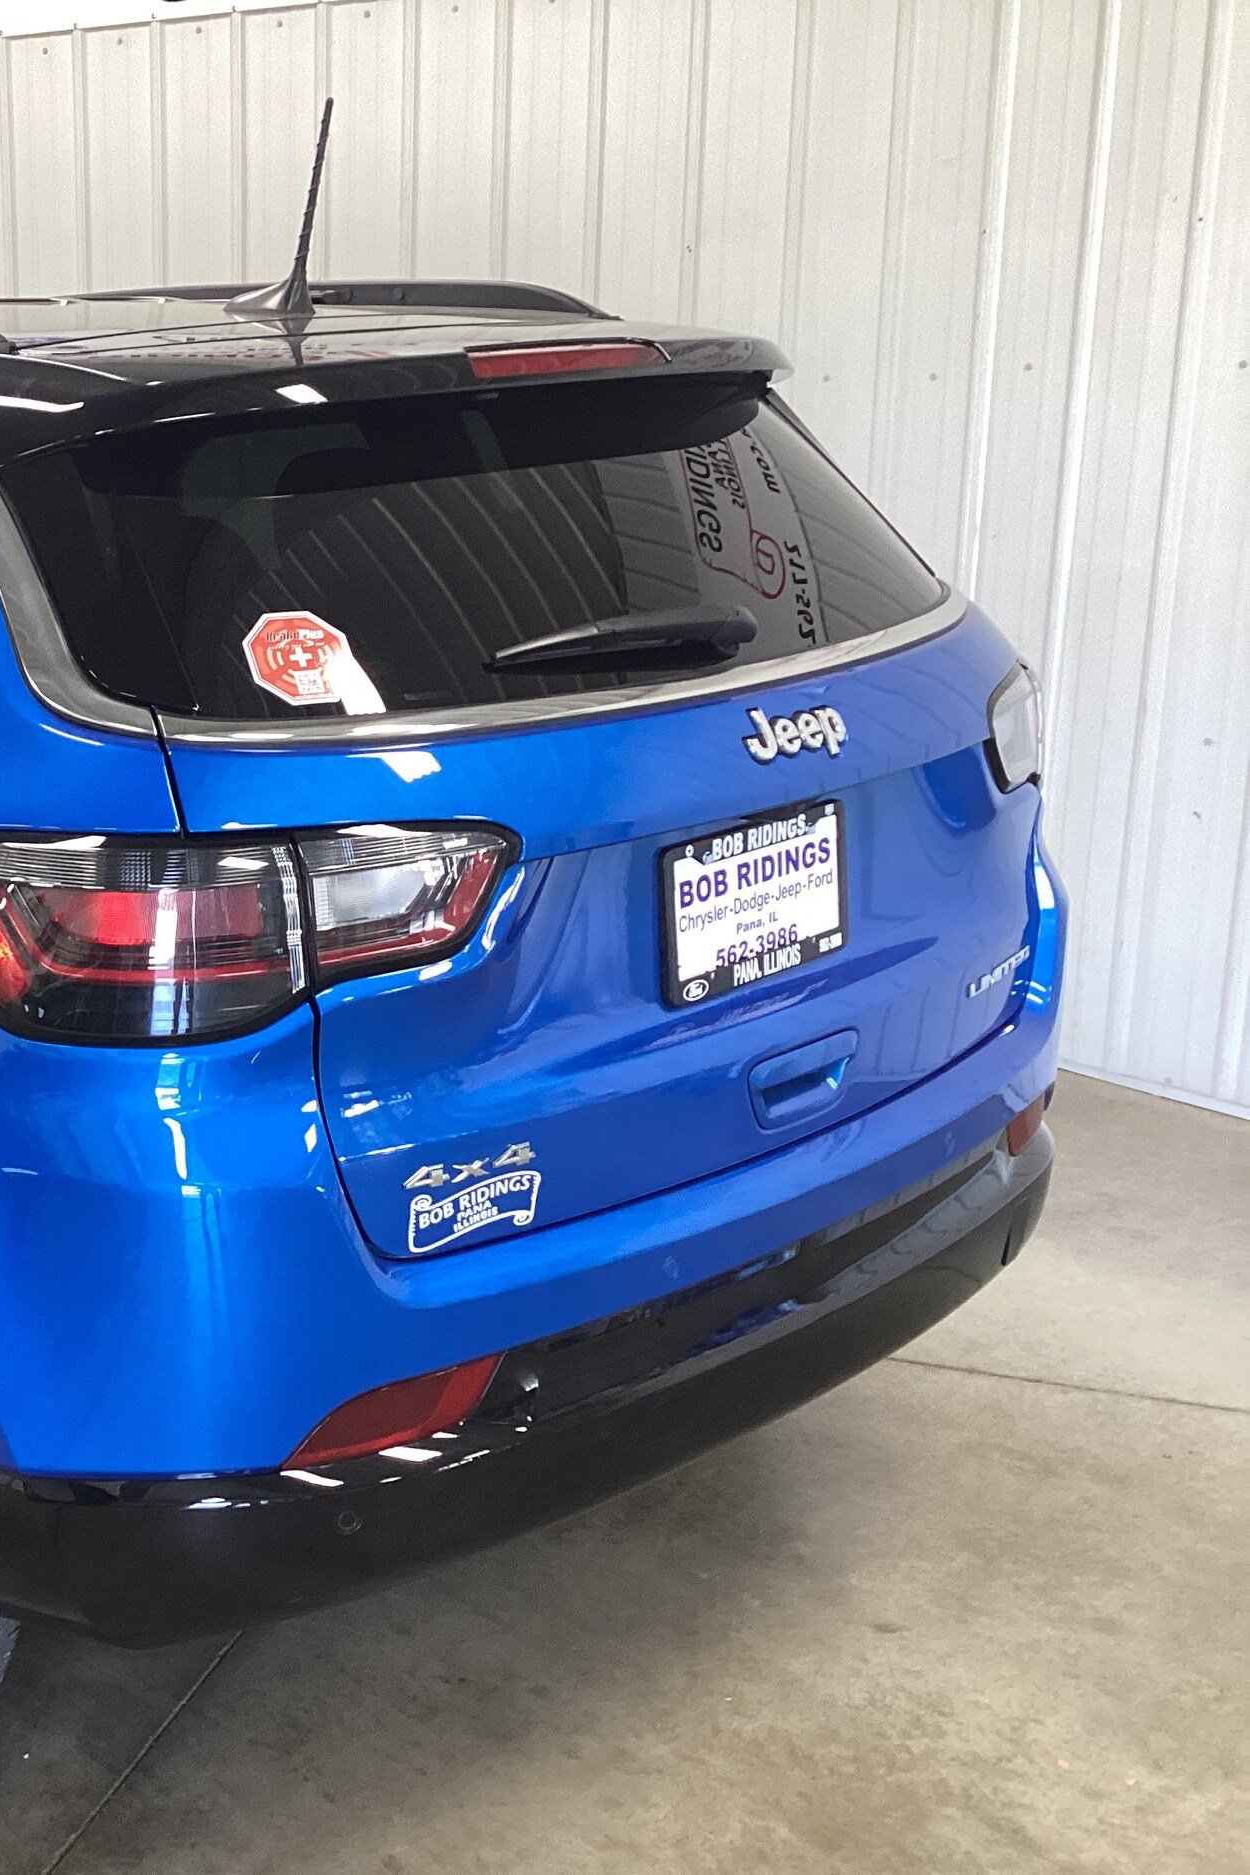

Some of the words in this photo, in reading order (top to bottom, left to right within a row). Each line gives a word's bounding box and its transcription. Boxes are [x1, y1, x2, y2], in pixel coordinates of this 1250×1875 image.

[741, 705, 847, 764] Jeep
[712, 832, 744, 860] BOB
[747, 814, 806, 851] RIDINGS
[679, 869, 728, 909] BOB
[737, 837, 831, 890] RIDINGS
[736, 916, 765, 934] Pana,
[768, 911, 779, 924] IL
[716, 923, 798, 967] 562-3986
[763, 943, 801, 976] ILLINOIS
[418, 1203, 455, 1229] BOB
[459, 1175, 531, 1211] RIDINGS
[453, 1206, 499, 1233] ILLINOIS
[457, 1200, 492, 1222] PANA
